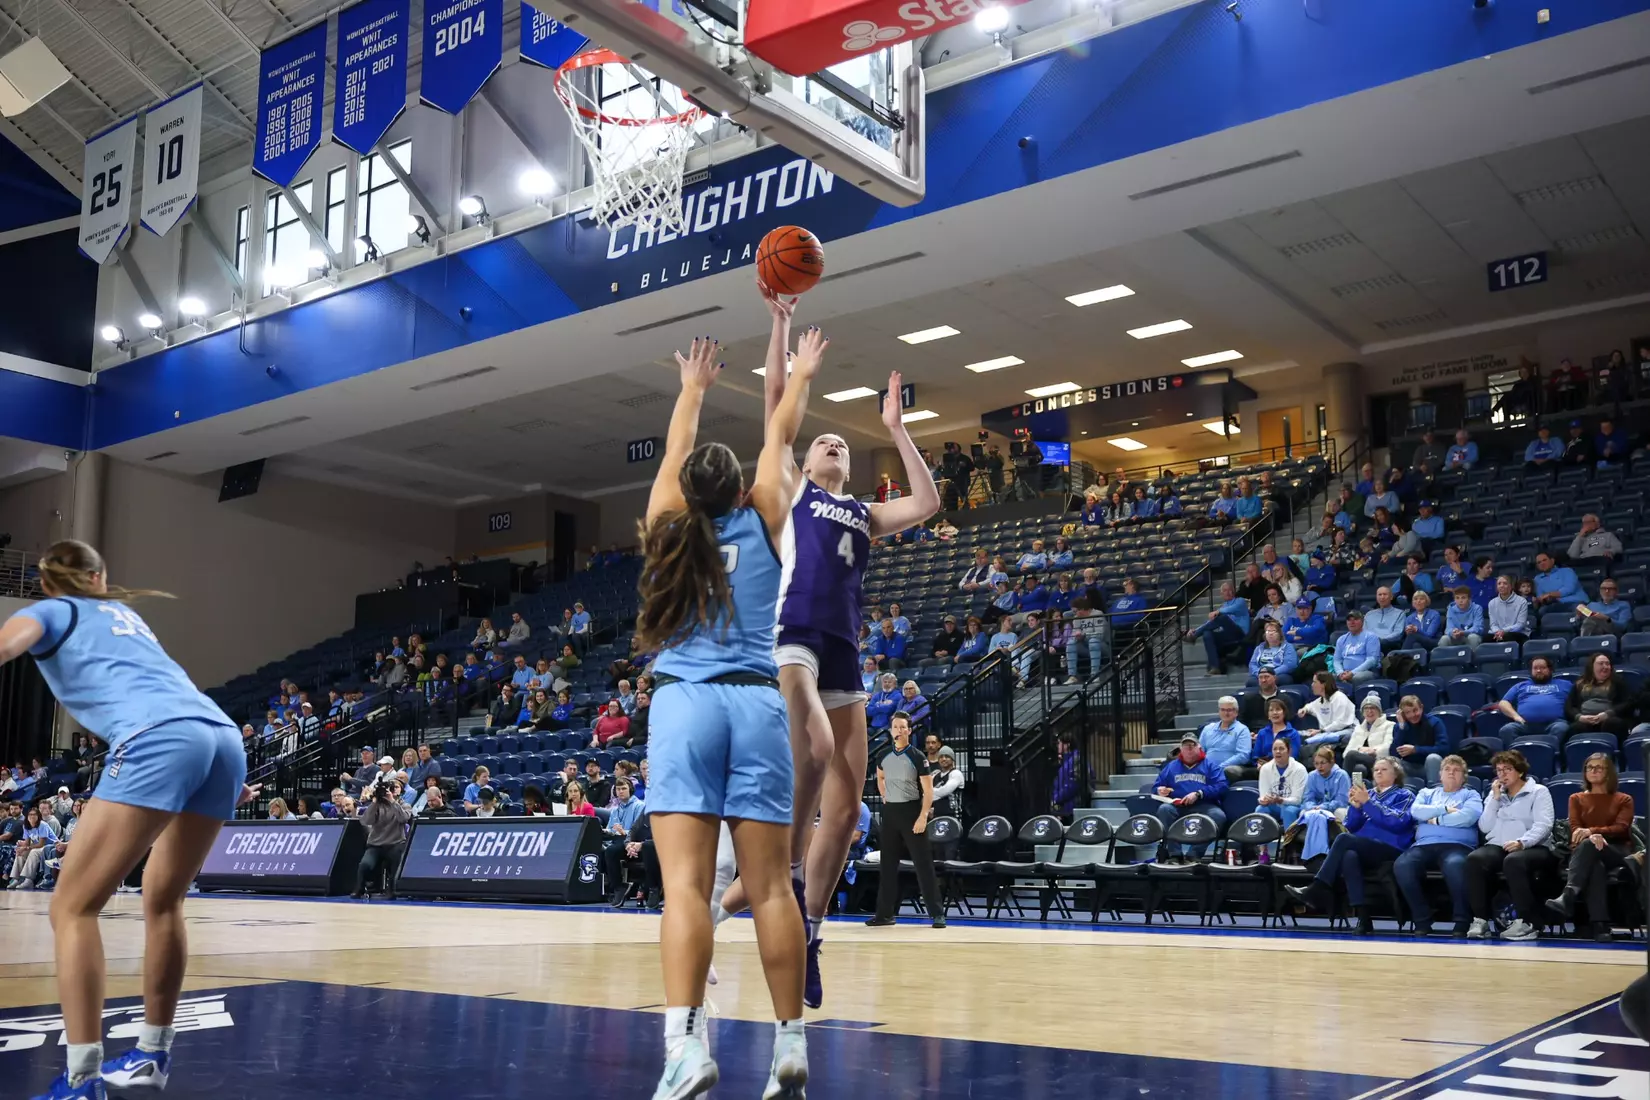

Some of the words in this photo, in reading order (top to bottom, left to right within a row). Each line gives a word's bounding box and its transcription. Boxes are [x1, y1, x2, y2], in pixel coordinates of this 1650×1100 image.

[346, 26, 370, 41] WOMEN'S
[370, 10, 399, 30] BASKETBALL
[431, 0, 484, 26] CHAMPIONS
[362, 29, 382, 47] WNIT
[435, 10, 485, 57] 2004
[533, 20, 558, 45] 2012
[345, 33, 398, 68] APPEARANCES
[282, 68, 300, 85] WNIT
[346, 67, 367, 87] 2011
[372, 54, 394, 76] 2021
[266, 74, 315, 104] APPEARANCES
[345, 81, 367, 101] 2014
[268, 103, 287, 122] 1987
[291, 92, 313, 112] 2005
[344, 95, 365, 115] 2015
[160, 116, 184, 135] WARREN
[343, 109, 365, 128] 2016
[103, 149, 116, 162] YORI
[158, 134, 184, 185] 10
[264, 144, 286, 162] 2004
[289, 132, 309, 151] 2010
[90, 164, 122, 216] 25
[1494, 257, 1542, 287] 112
[1392, 371, 1419, 386] HALL
[1422, 369, 1436, 381] OF
[1439, 364, 1469, 378] FAME
[1473, 358, 1508, 372] ROOM
[1022, 376, 1168, 417] CONCESSIONS
[629, 440, 654, 460] 110
[490, 513, 511, 531] 109
[809, 501, 871, 541] Wildca
[837, 531, 855, 567] 4
[225, 832, 323, 855] CREIGHTON
[430, 831, 555, 857] CREIGHTON
[233, 862, 297, 872] BLUEJAYS
[443, 865, 524, 877] BLUEJAYS
